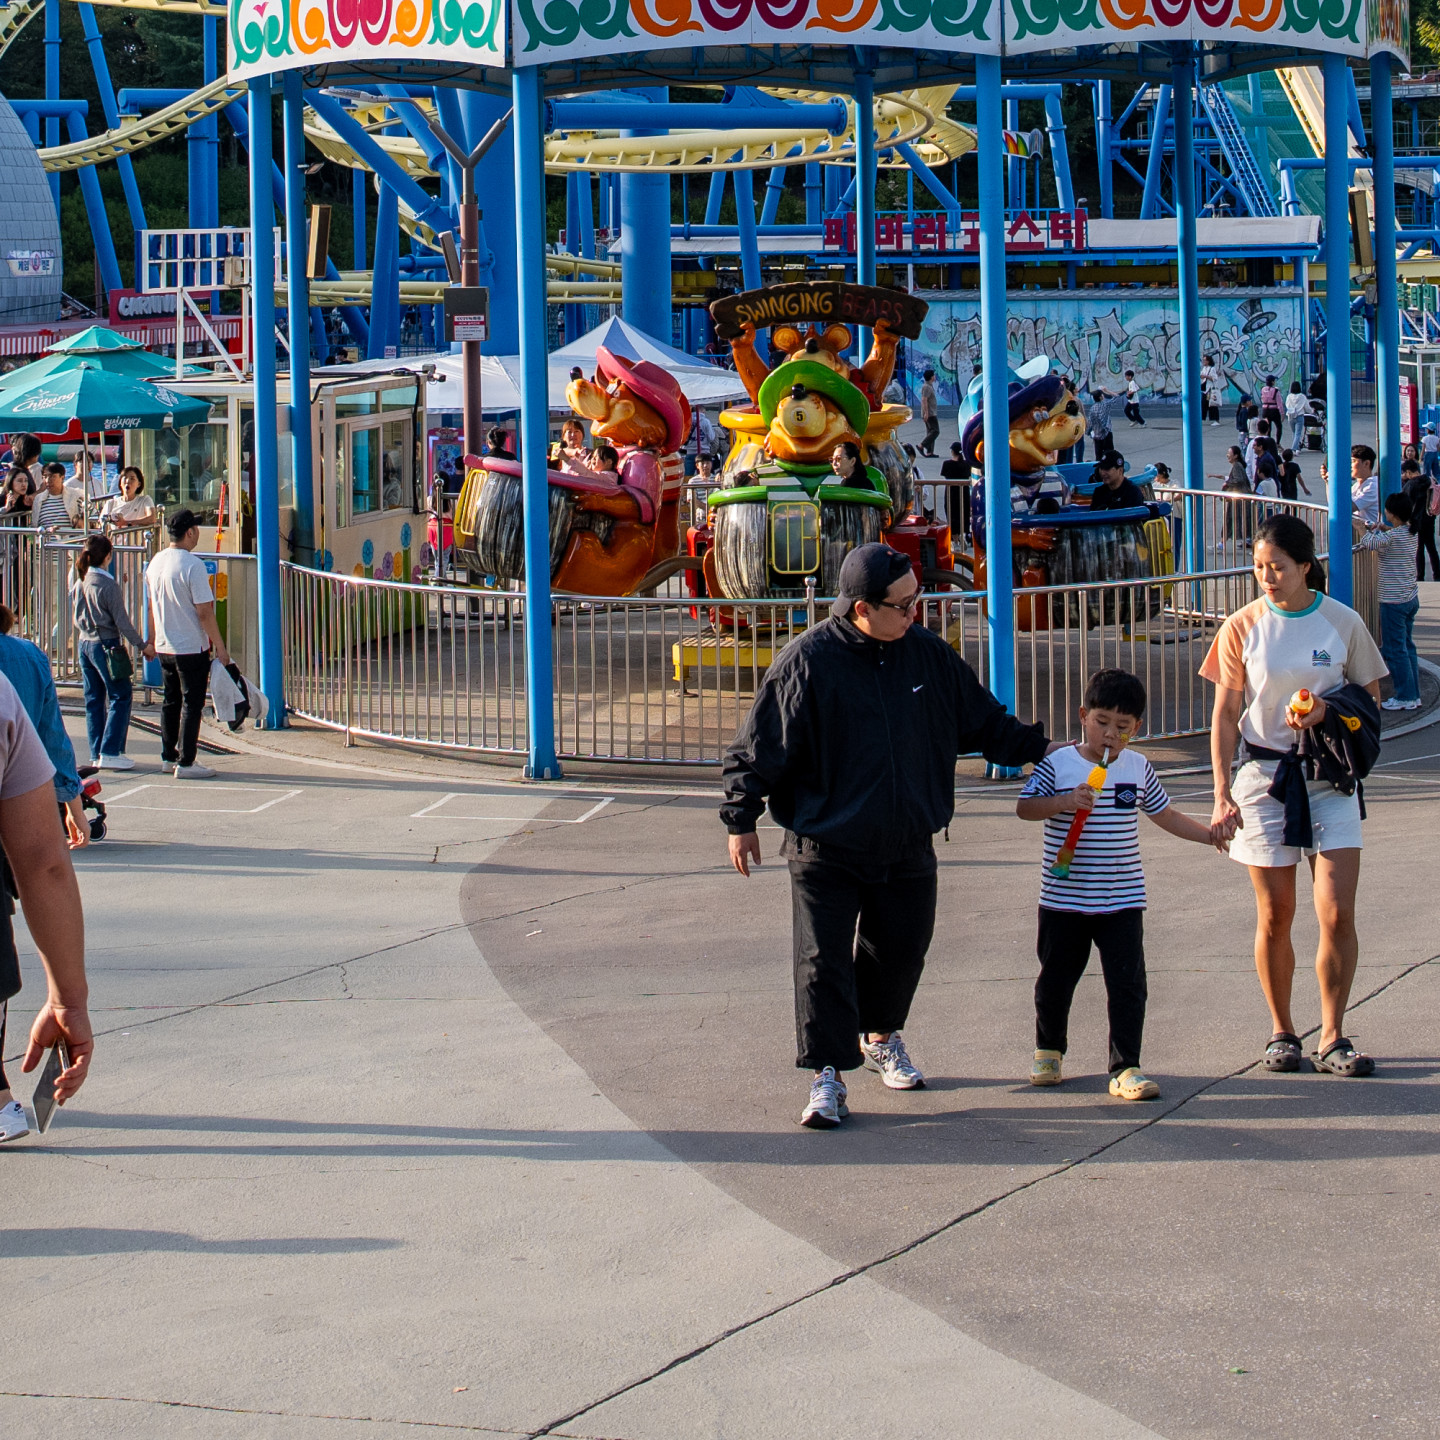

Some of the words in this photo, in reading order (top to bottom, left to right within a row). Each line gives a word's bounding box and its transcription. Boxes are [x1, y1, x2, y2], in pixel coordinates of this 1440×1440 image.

[735, 291, 834, 324] SWINGING
[842, 292, 903, 327] BEARS
[795, 410, 804, 421] 5
[104, 416, 142, 429] 칠성사이다
